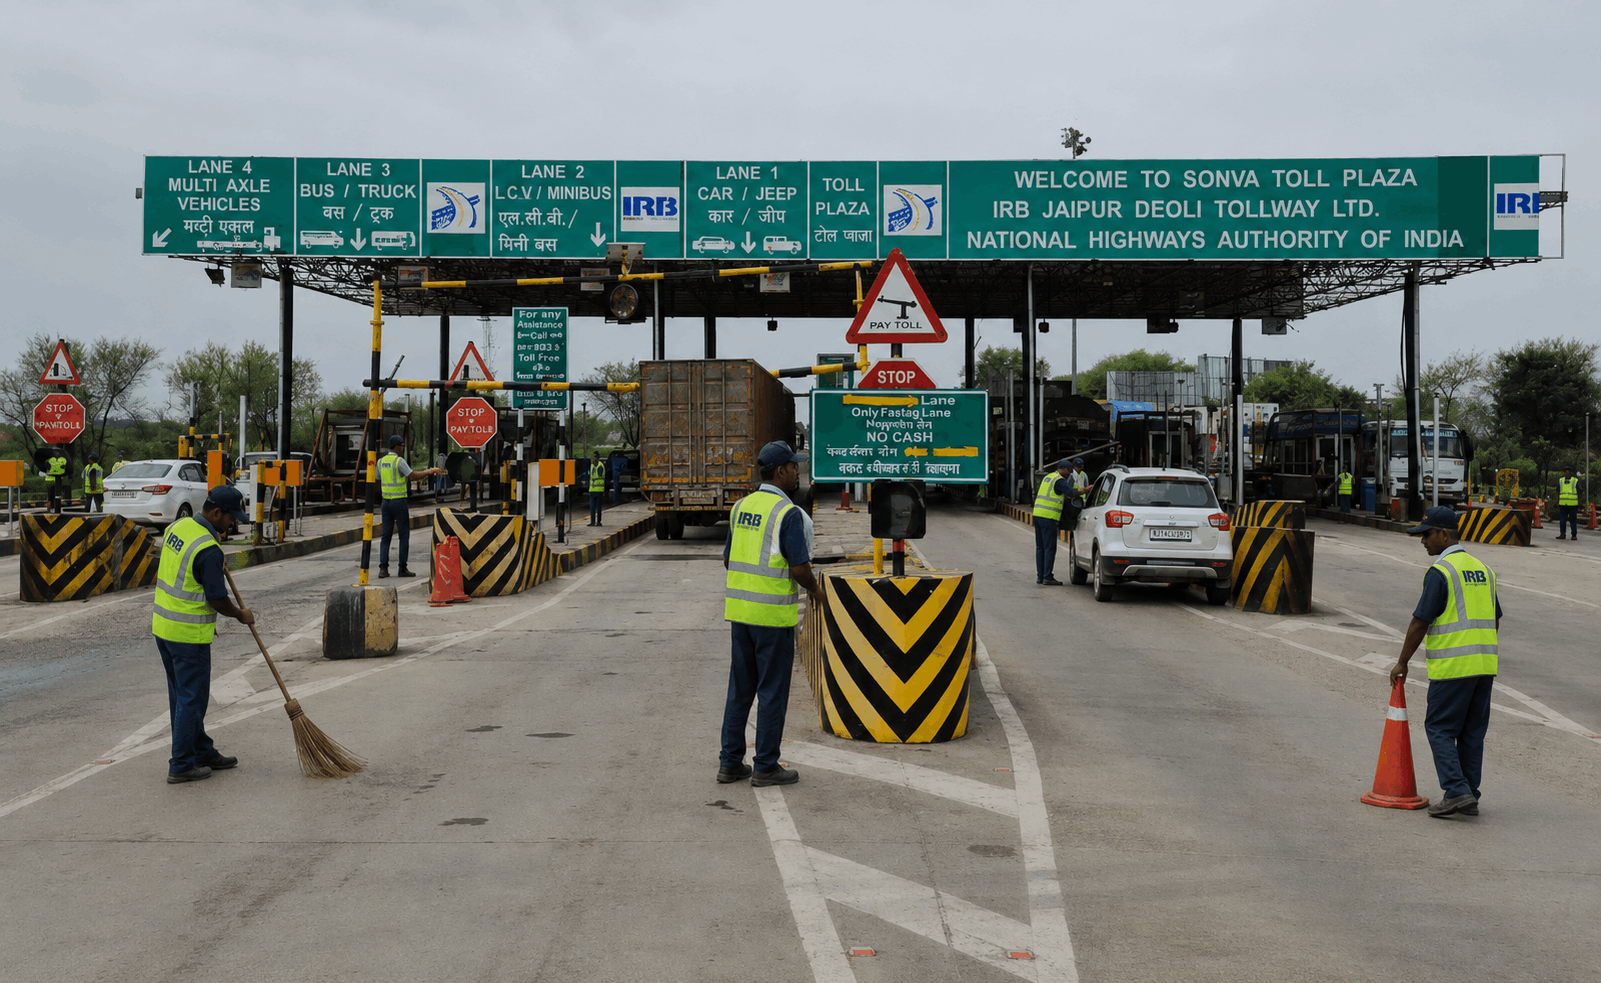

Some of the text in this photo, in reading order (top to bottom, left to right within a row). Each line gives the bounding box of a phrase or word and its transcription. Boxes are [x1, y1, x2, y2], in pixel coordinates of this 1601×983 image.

[189, 160, 252, 173] LANE 4
[328, 162, 390, 176] LANE 3
[522, 165, 584, 178] LANE 2
[717, 166, 777, 179] LANE 1
[169, 178, 270, 192] MULTI AXLE
[823, 178, 864, 191] TOLL
[1015, 169, 1417, 188] WELCOME TO SONVA TOLL PLAZA
[301, 184, 416, 198] BUS / TRUCK
[548, 186, 611, 199] MINIBUS
[698, 187, 796, 200] CAR / JEEP
[178, 197, 260, 211] VEHICLES
[623, 196, 678, 216] IRB
[816, 202, 869, 215] PLAZA
[994, 200, 1379, 218] IRB JAIPUR DEOLI TOLLWAY LTD.
[708, 205, 786, 225] कार / जीप
[814, 225, 838, 242] टोल
[968, 230, 1463, 248] NATIONAL HIGHWAYS AUTHORITY OF INDIA
[499, 234, 557, 251] मिनी बस
[542, 312, 561, 320] any
[877, 370, 915, 384] STOP
[921, 396, 955, 405] Lane
[458, 408, 484, 416] STOP
[852, 407, 950, 420] Only Fastag Lane
[867, 432, 932, 443] NO CASH
[738, 512, 761, 526] IRB
[167, 533, 184, 551] IRB
[1462, 571, 1486, 582] IRB
